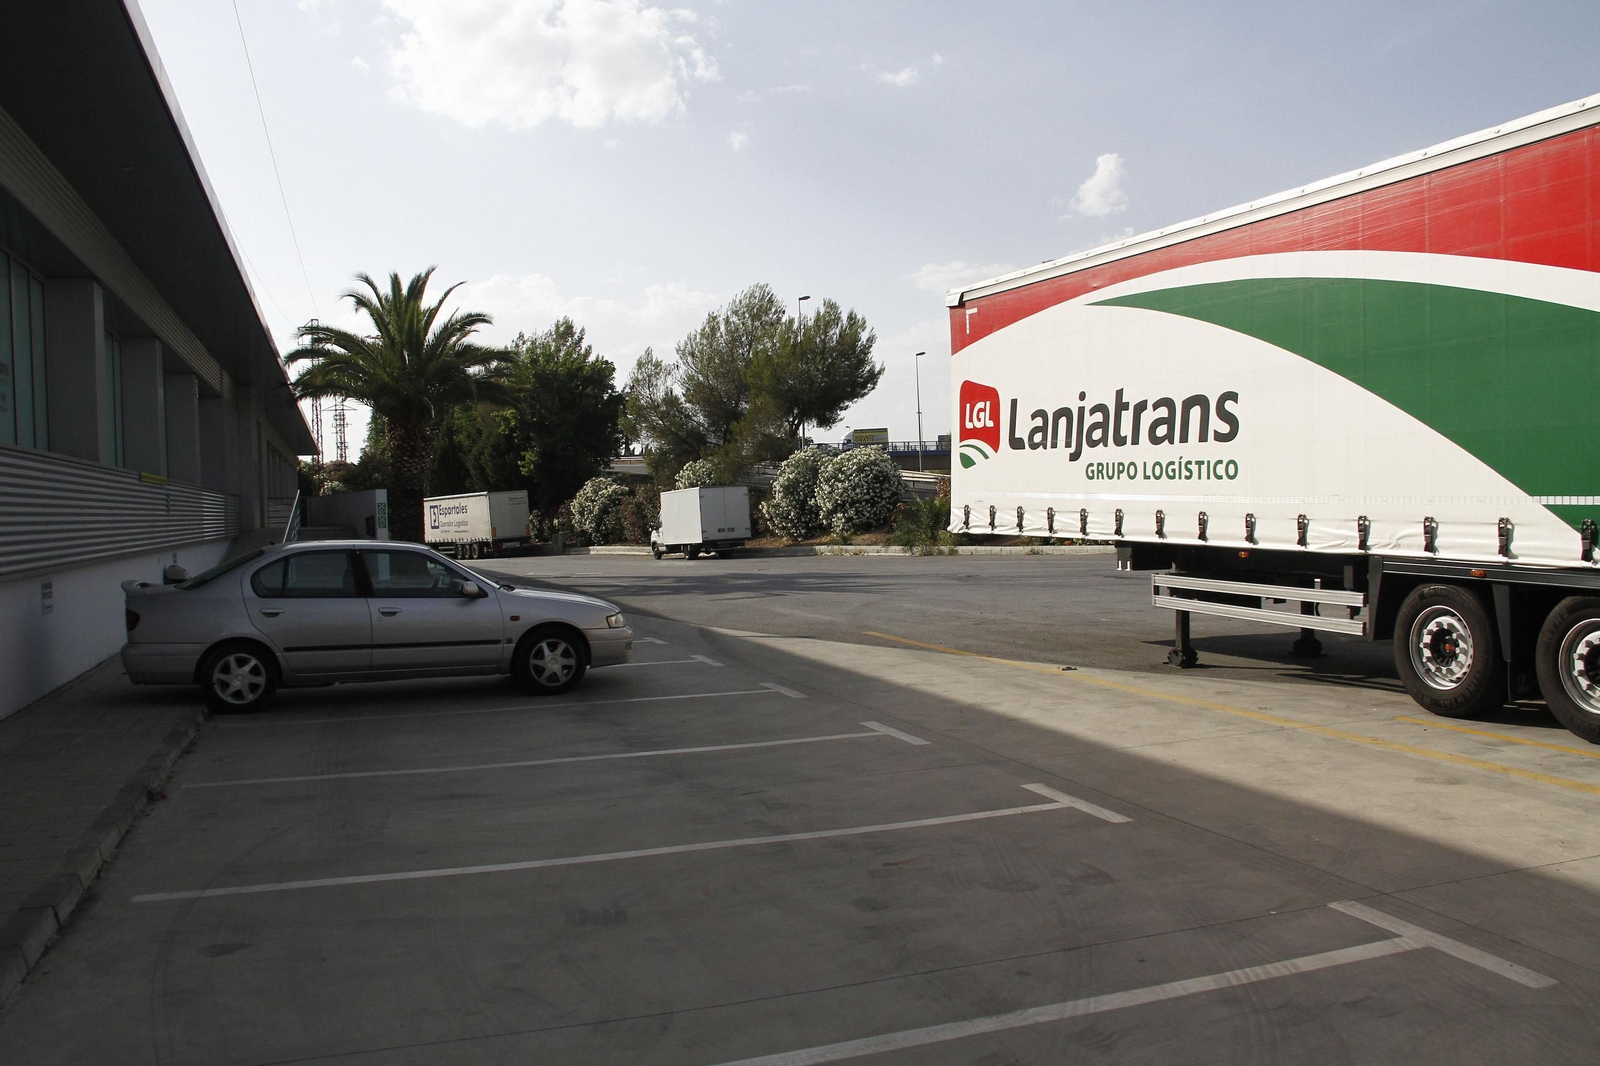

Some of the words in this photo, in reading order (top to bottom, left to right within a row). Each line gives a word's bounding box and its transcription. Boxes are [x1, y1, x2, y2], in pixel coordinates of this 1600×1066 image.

[965, 401, 994, 429] LGL
[1008, 387, 1240, 462] Lanjatrans
[1085, 461, 1138, 480] GRUPO
[1143, 456, 1239, 481] LOGÍSTICO
[439, 502, 467, 517] Esportales
